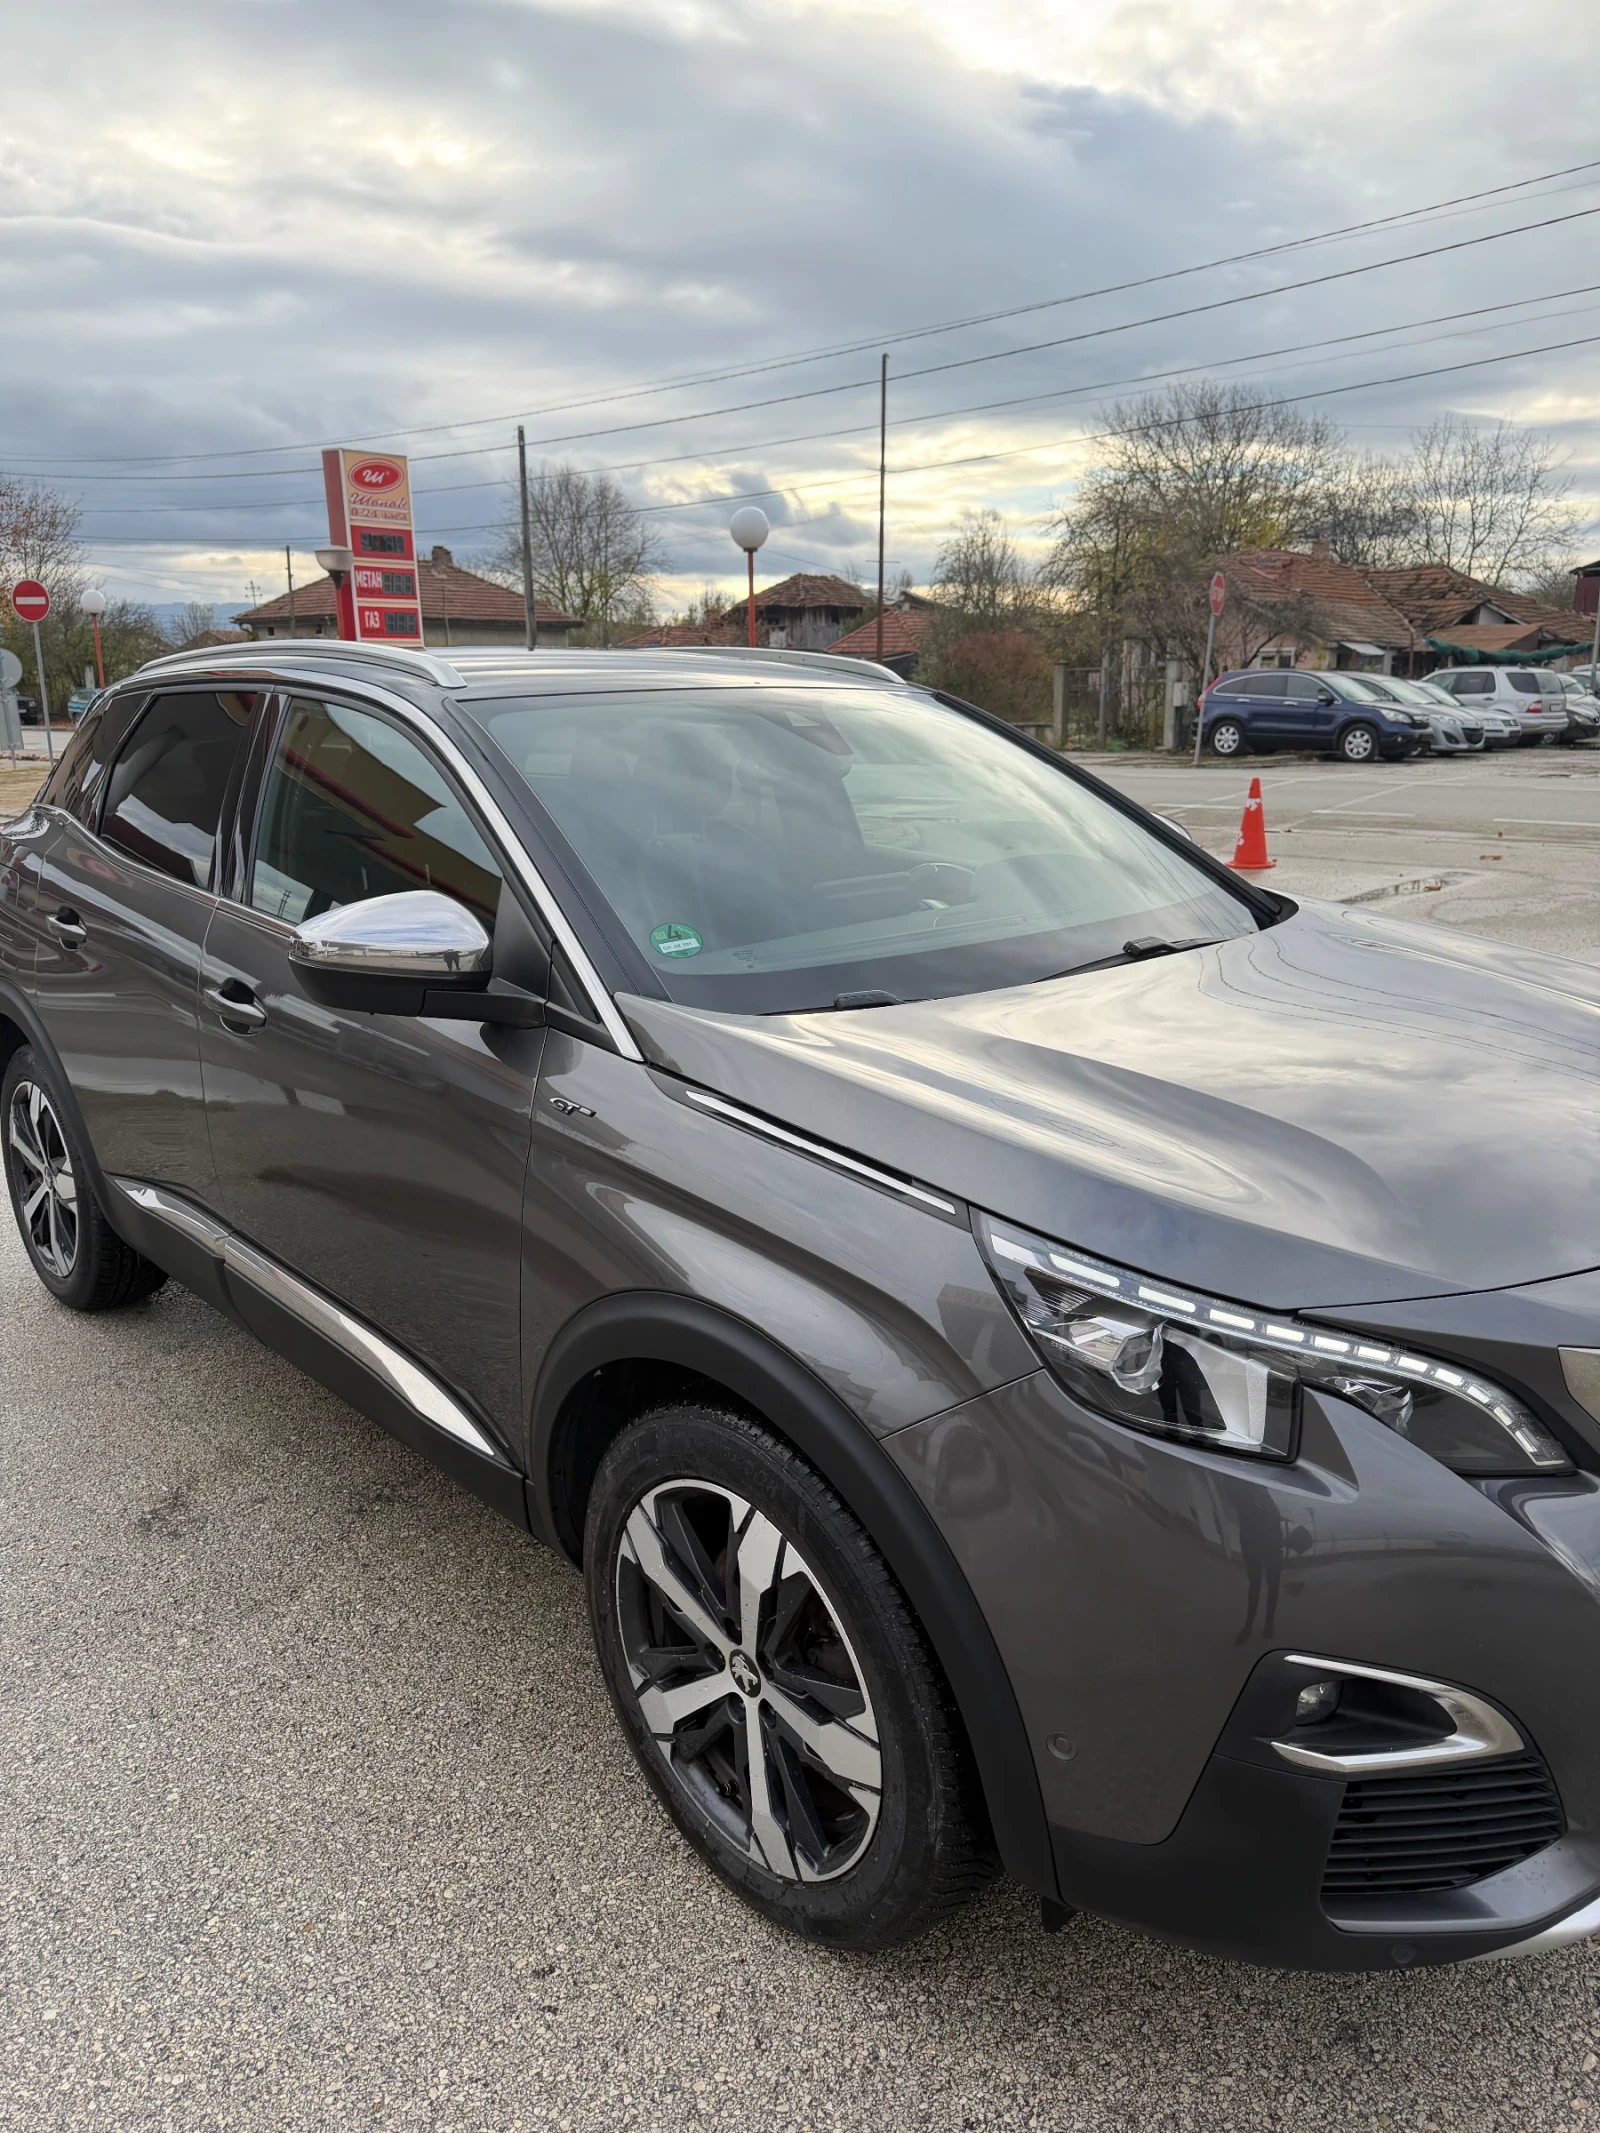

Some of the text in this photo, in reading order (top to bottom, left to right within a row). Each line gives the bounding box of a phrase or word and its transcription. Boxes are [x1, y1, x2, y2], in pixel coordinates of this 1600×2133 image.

[355, 570, 383, 588] МЕТАН
[1210, 586, 1224, 602] STOP
[364, 610, 380, 628] ГАЗ
[667, 924, 683, 940] 4
[549, 1097, 581, 1116] GT
